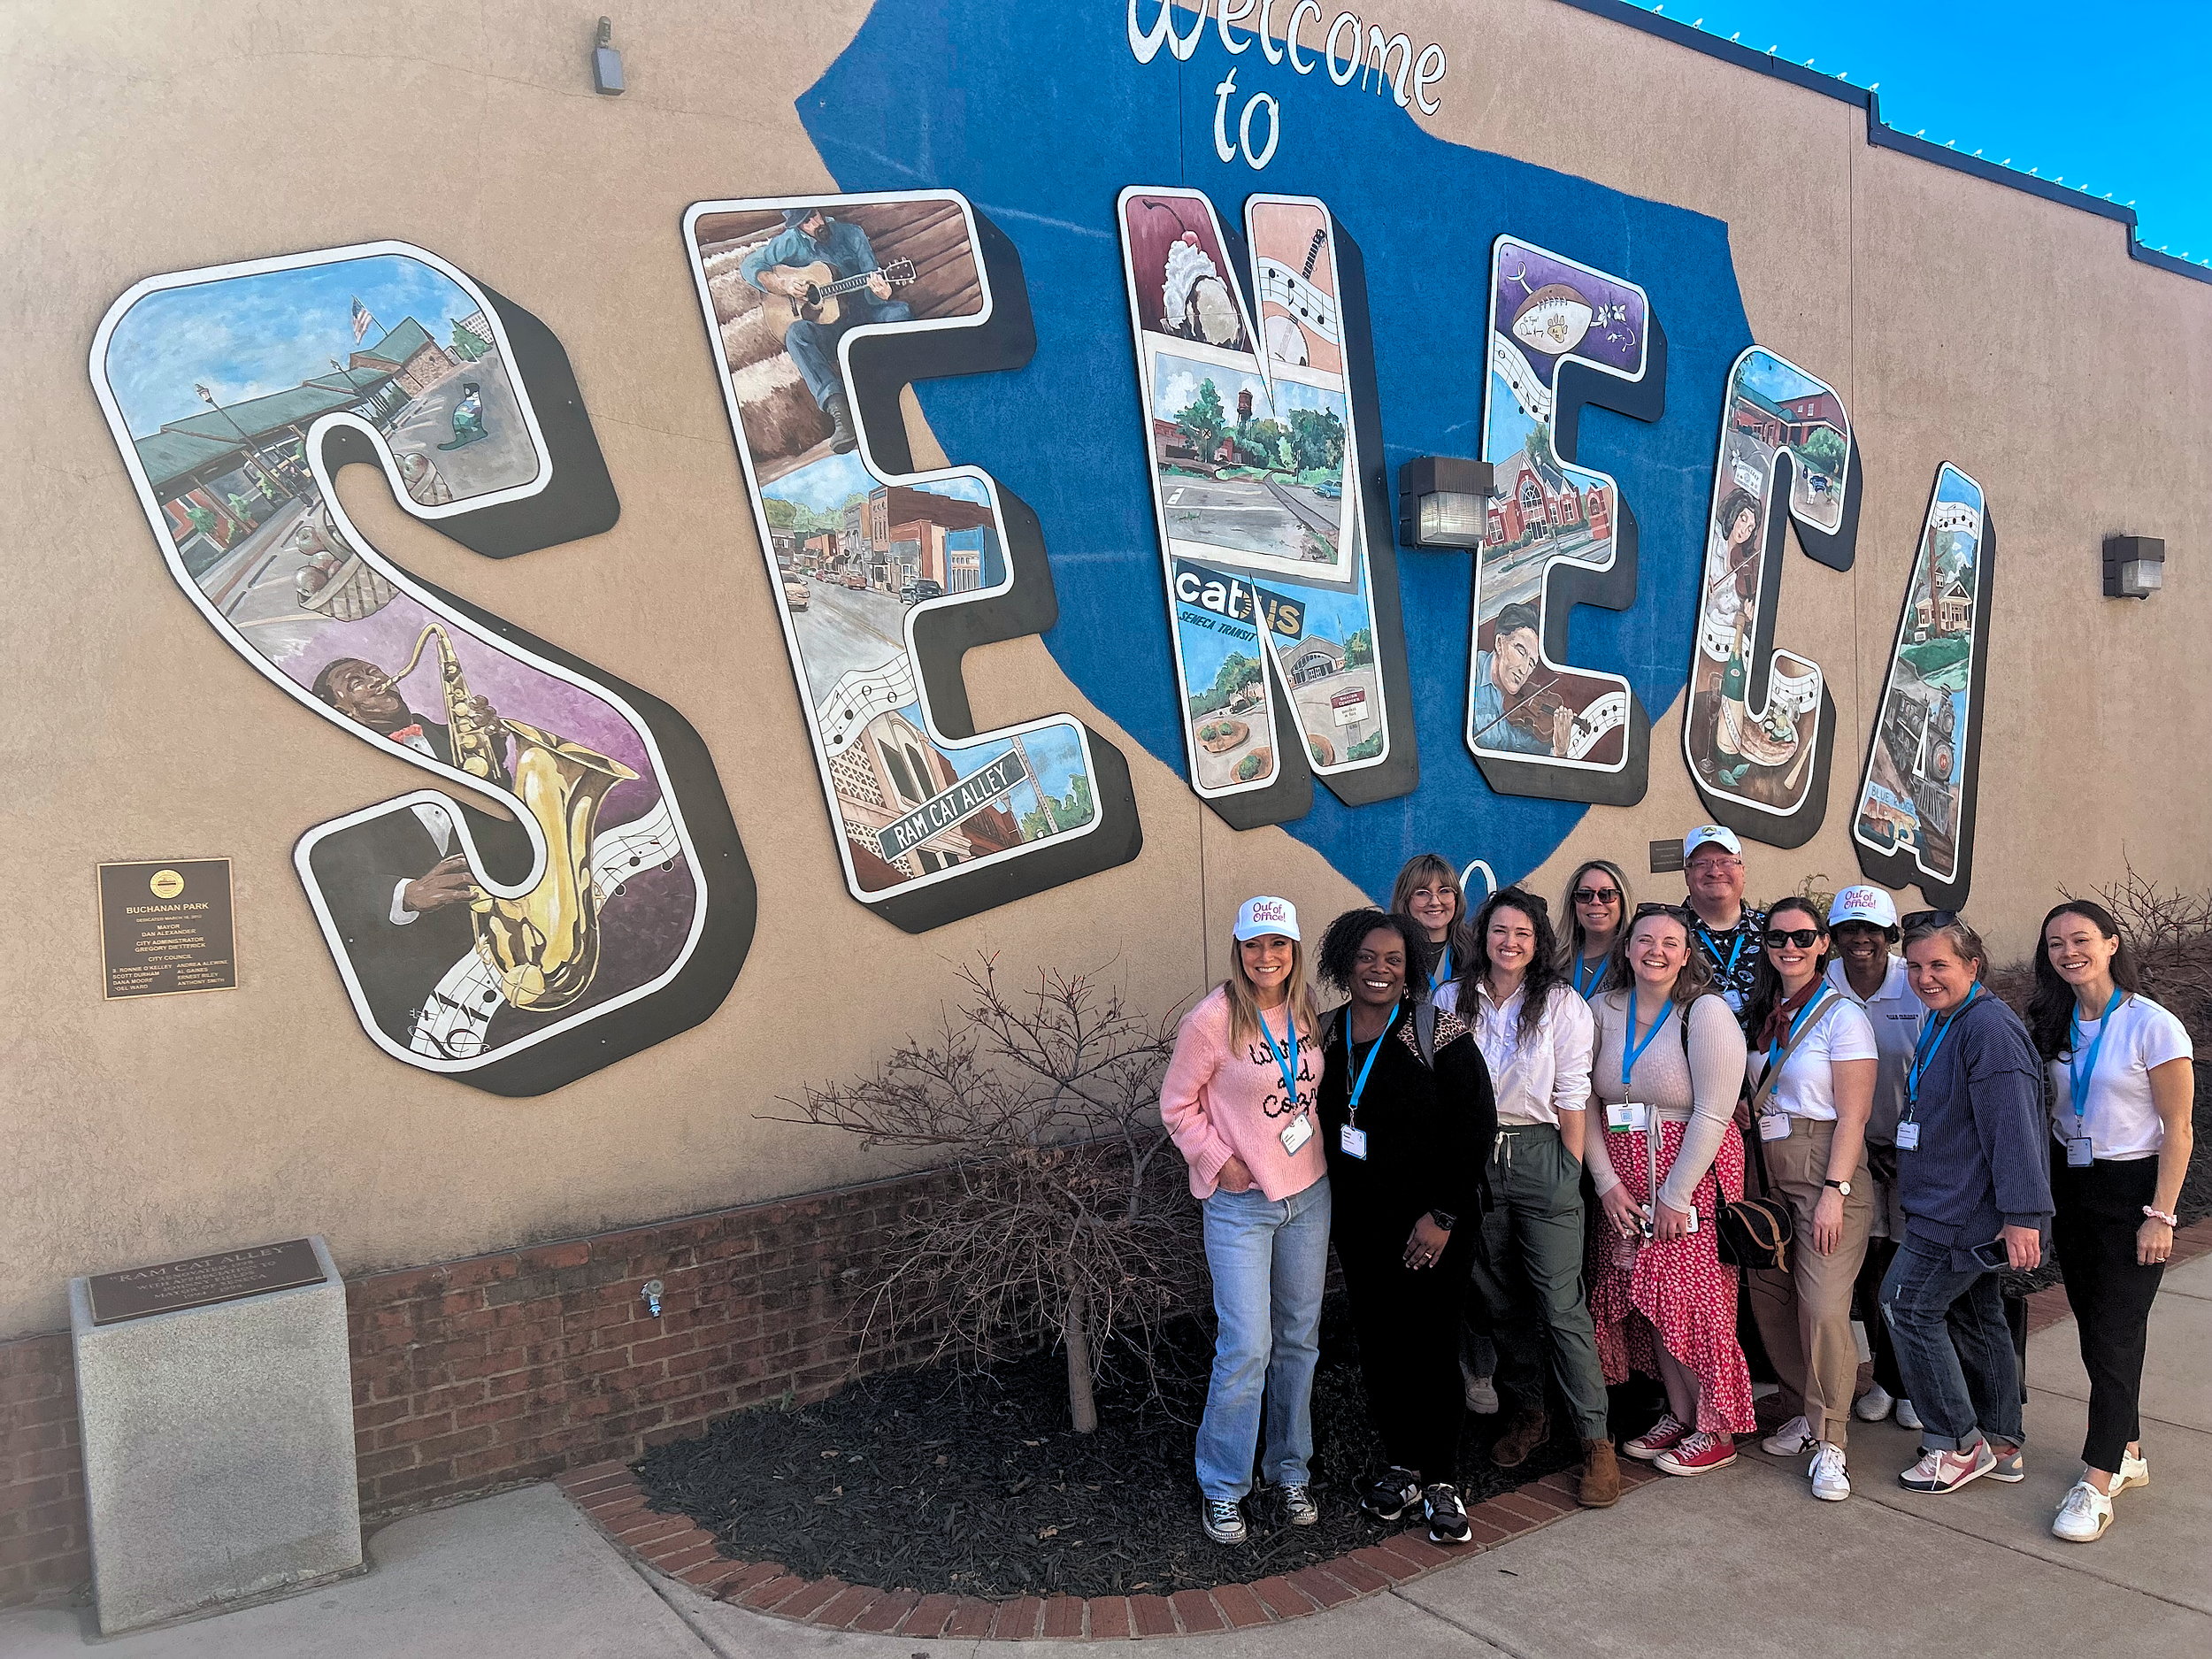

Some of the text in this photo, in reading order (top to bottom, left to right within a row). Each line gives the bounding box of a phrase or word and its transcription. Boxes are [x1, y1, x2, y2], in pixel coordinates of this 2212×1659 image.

[1126, 0, 1448, 116] Welcome
[1213, 65, 1279, 171] to
[1179, 611, 1257, 642] SENECA TRANSIT
[90, 184, 1993, 1095] SENECA
[1871, 785, 1890, 803] BLUE
[893, 762, 1010, 849] RAM CAT ALLEY
[1843, 899, 1877, 910] Office!
[1845, 889, 1873, 902] Out of
[126, 902, 210, 914] BUCHANAN PARK
[1253, 901, 1282, 914] Out of
[1253, 912, 1286, 922] Office!
[1277, 1058, 1316, 1089] ad
[174, 1259, 213, 1271] CAT
